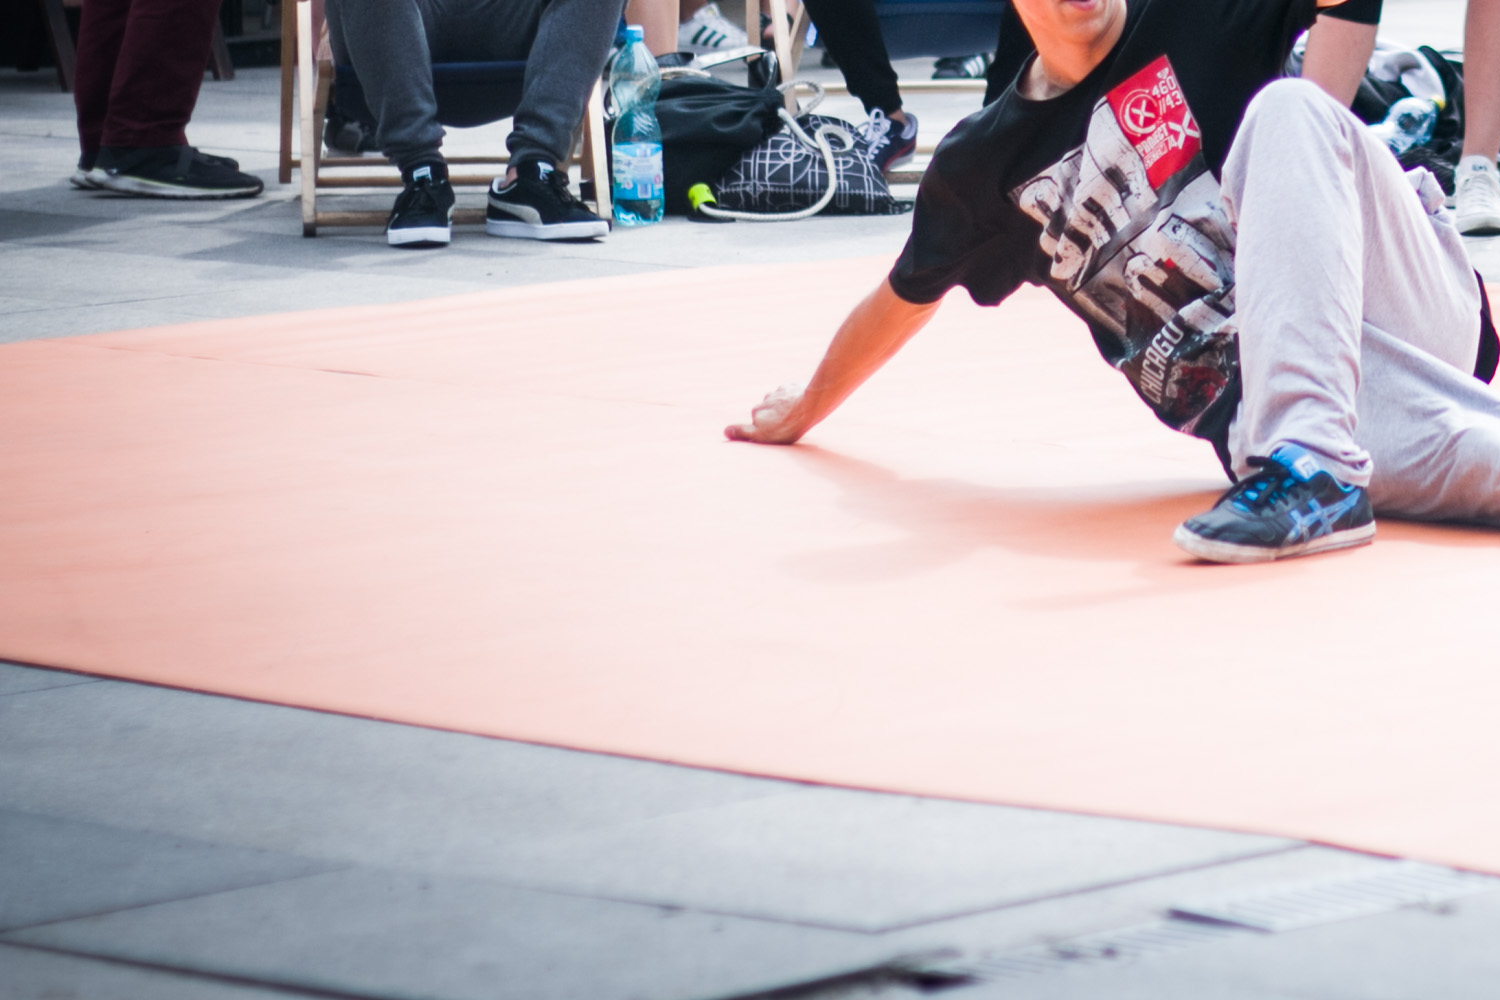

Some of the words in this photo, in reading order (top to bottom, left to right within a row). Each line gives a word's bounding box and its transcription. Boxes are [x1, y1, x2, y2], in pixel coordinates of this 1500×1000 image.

[1152, 75, 1178, 98] 460
[1135, 122, 1169, 157] PROJECT
[1138, 321, 1185, 405] CHICAGO
